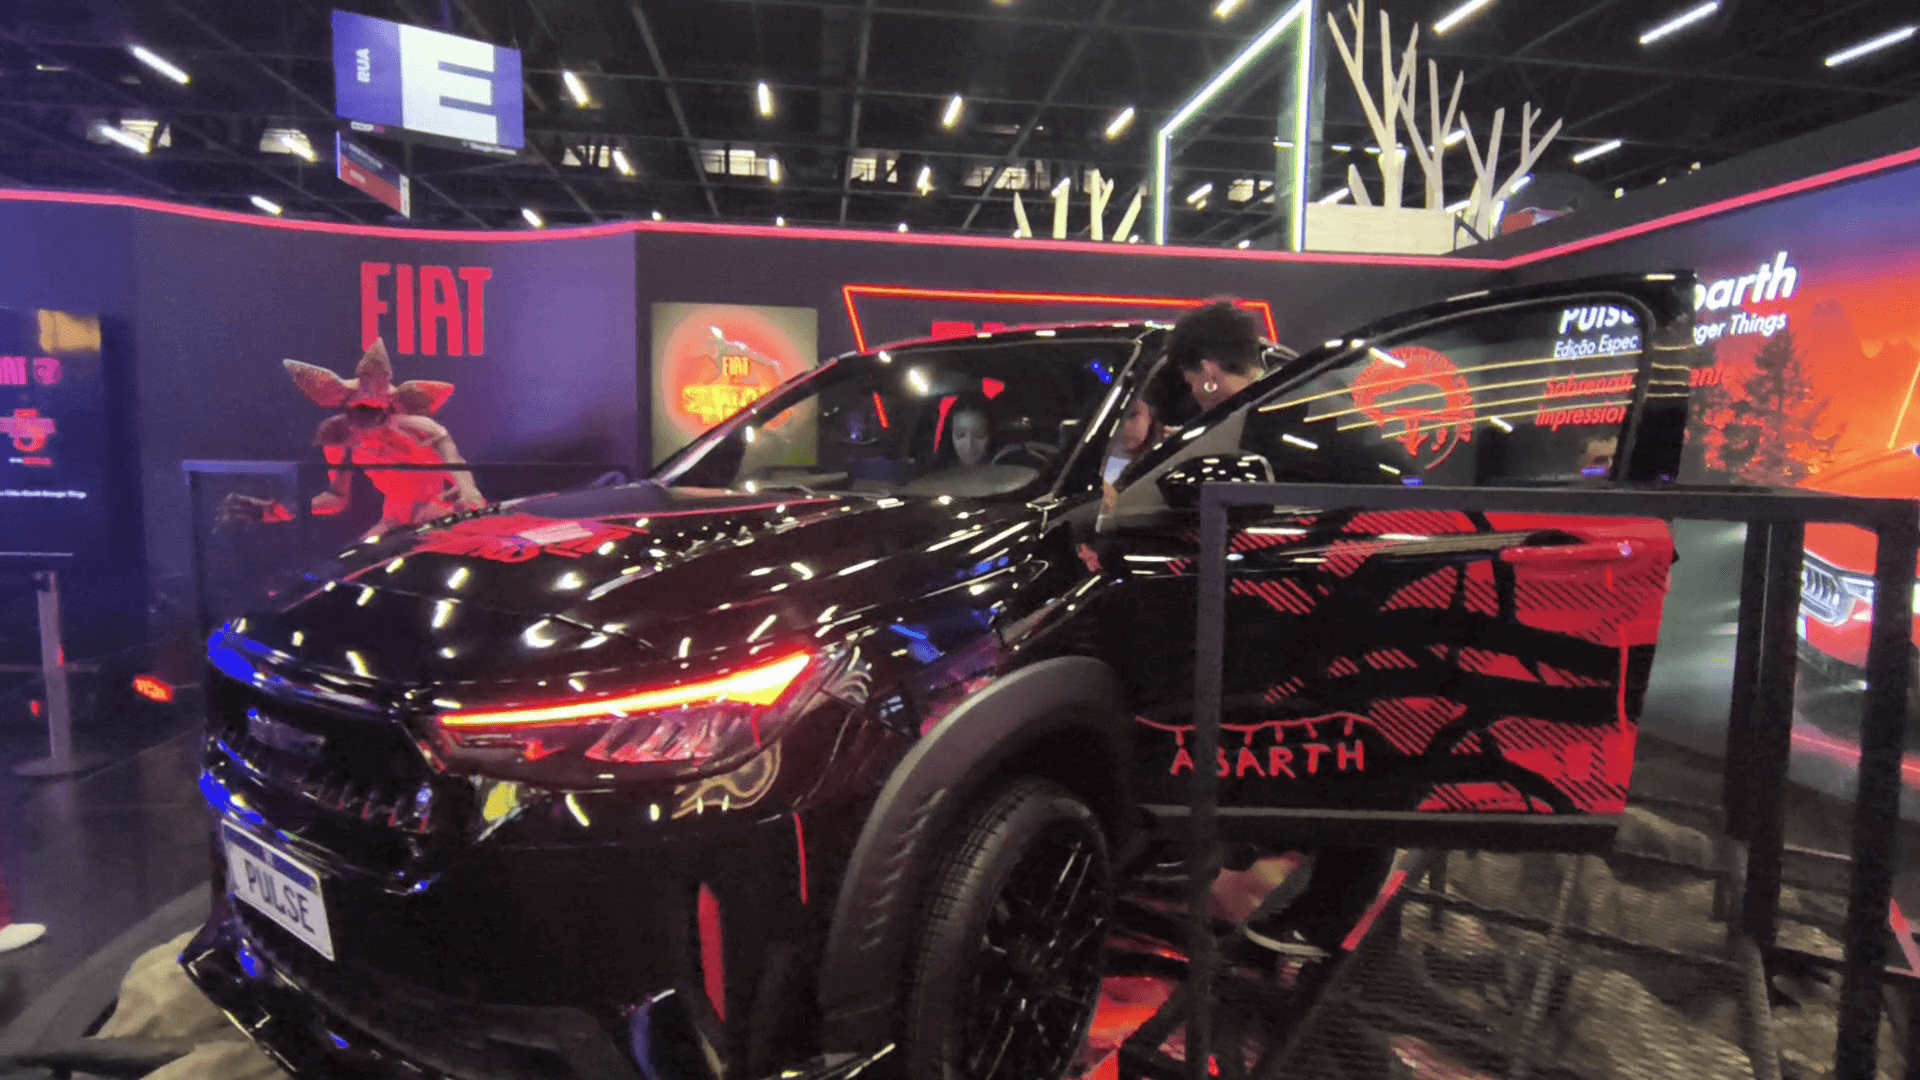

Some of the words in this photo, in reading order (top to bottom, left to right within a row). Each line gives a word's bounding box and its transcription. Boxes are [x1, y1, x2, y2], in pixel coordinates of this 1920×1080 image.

[356, 48, 370, 83] RUA
[399, 23, 497, 145] E
[361, 261, 493, 357] FIAT
[1693, 320, 1727, 346] ger
[1729, 312, 1787, 337] Things
[1554, 338, 1596, 360] Edição
[1598, 333, 1639, 357] Espec
[243, 857, 316, 935] PULSE
